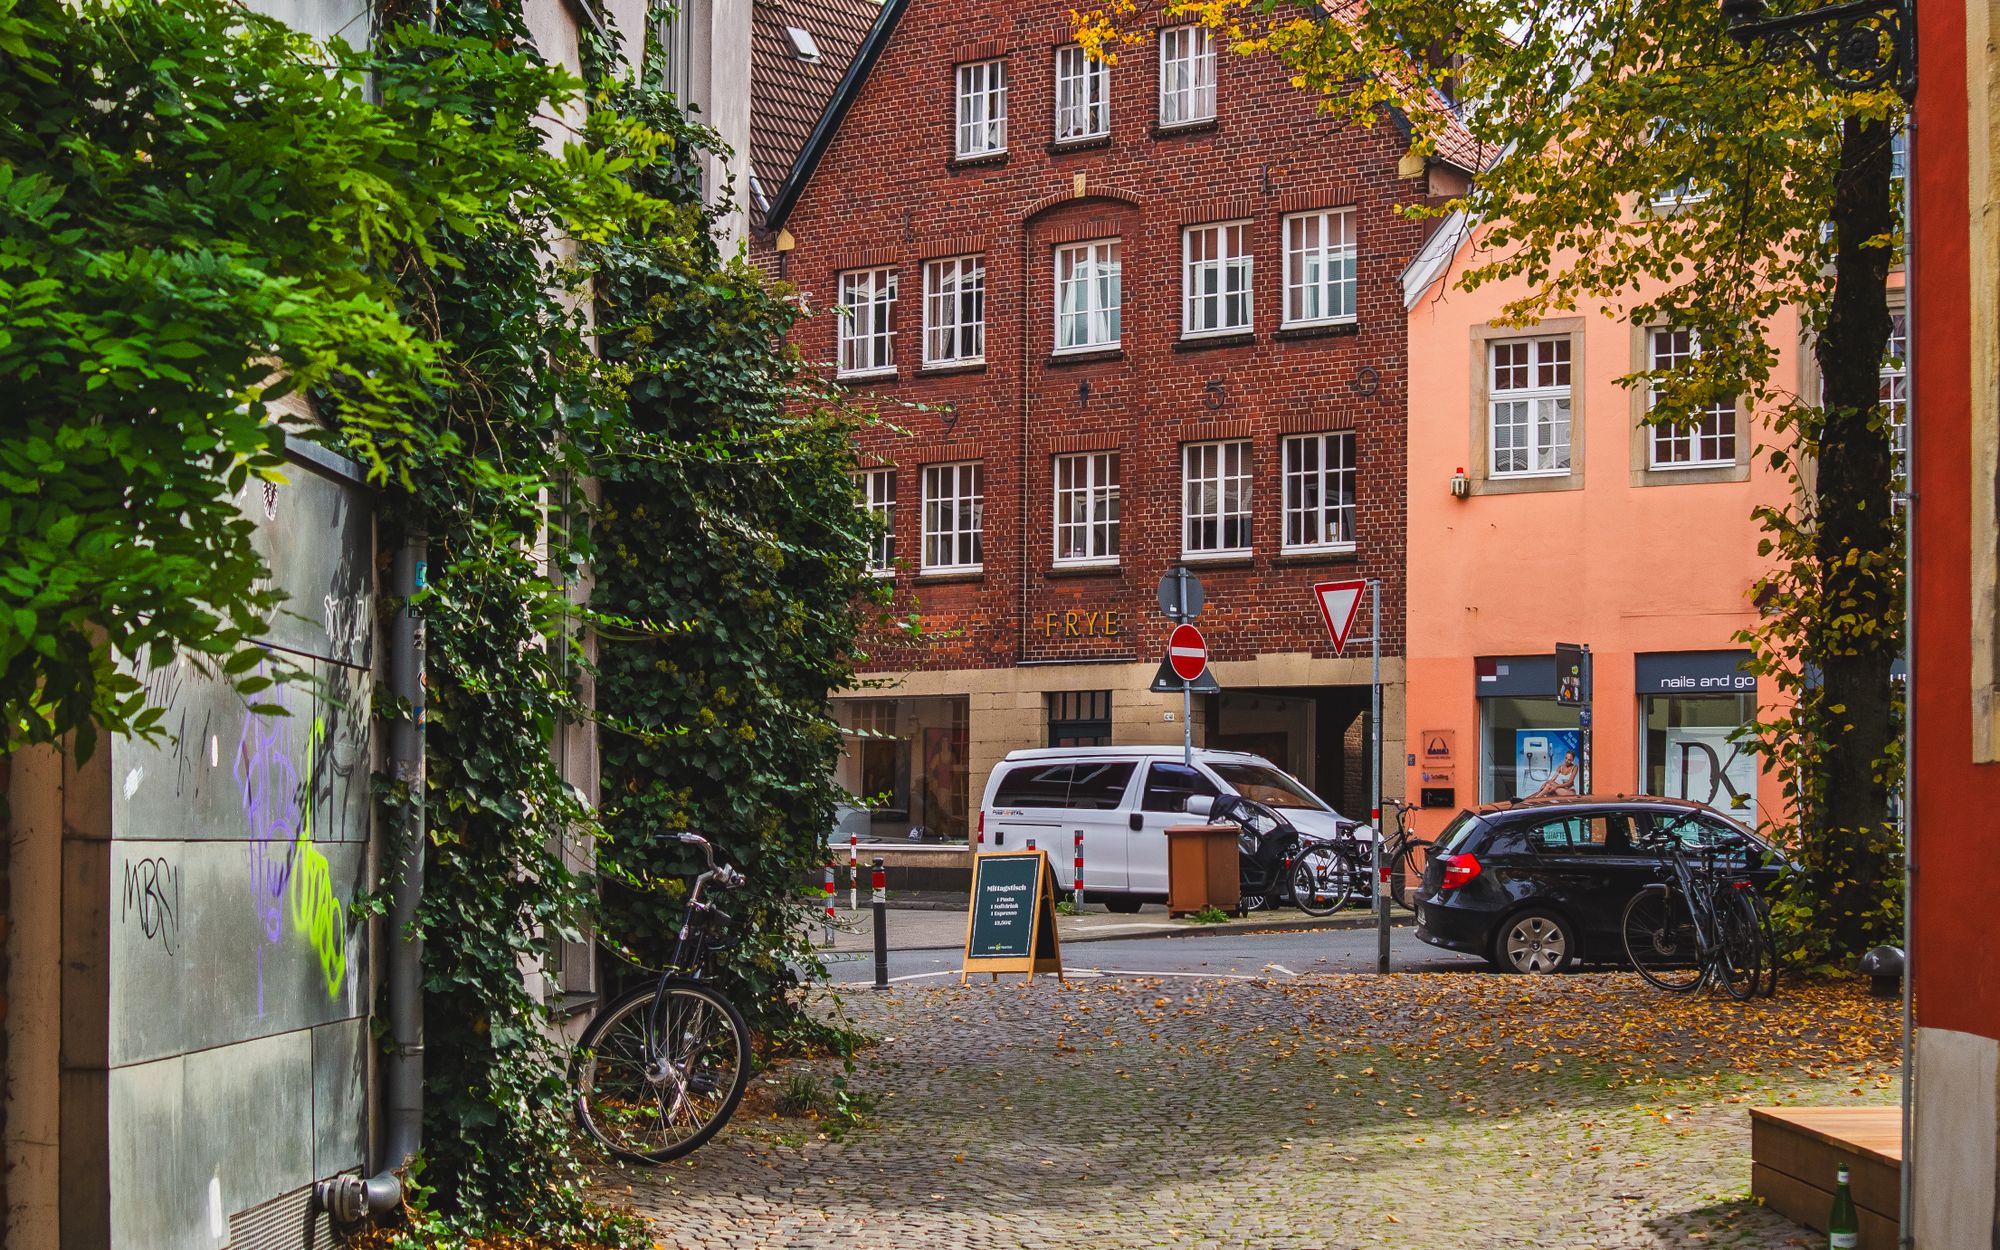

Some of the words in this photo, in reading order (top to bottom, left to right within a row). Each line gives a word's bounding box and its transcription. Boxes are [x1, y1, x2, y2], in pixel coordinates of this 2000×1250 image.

[1204, 376, 1225, 410] 5
[1045, 610, 1119, 637] FRYE
[1660, 675, 1696, 688] nails
[1700, 675, 1730, 687] and
[1734, 676, 1756, 689] go
